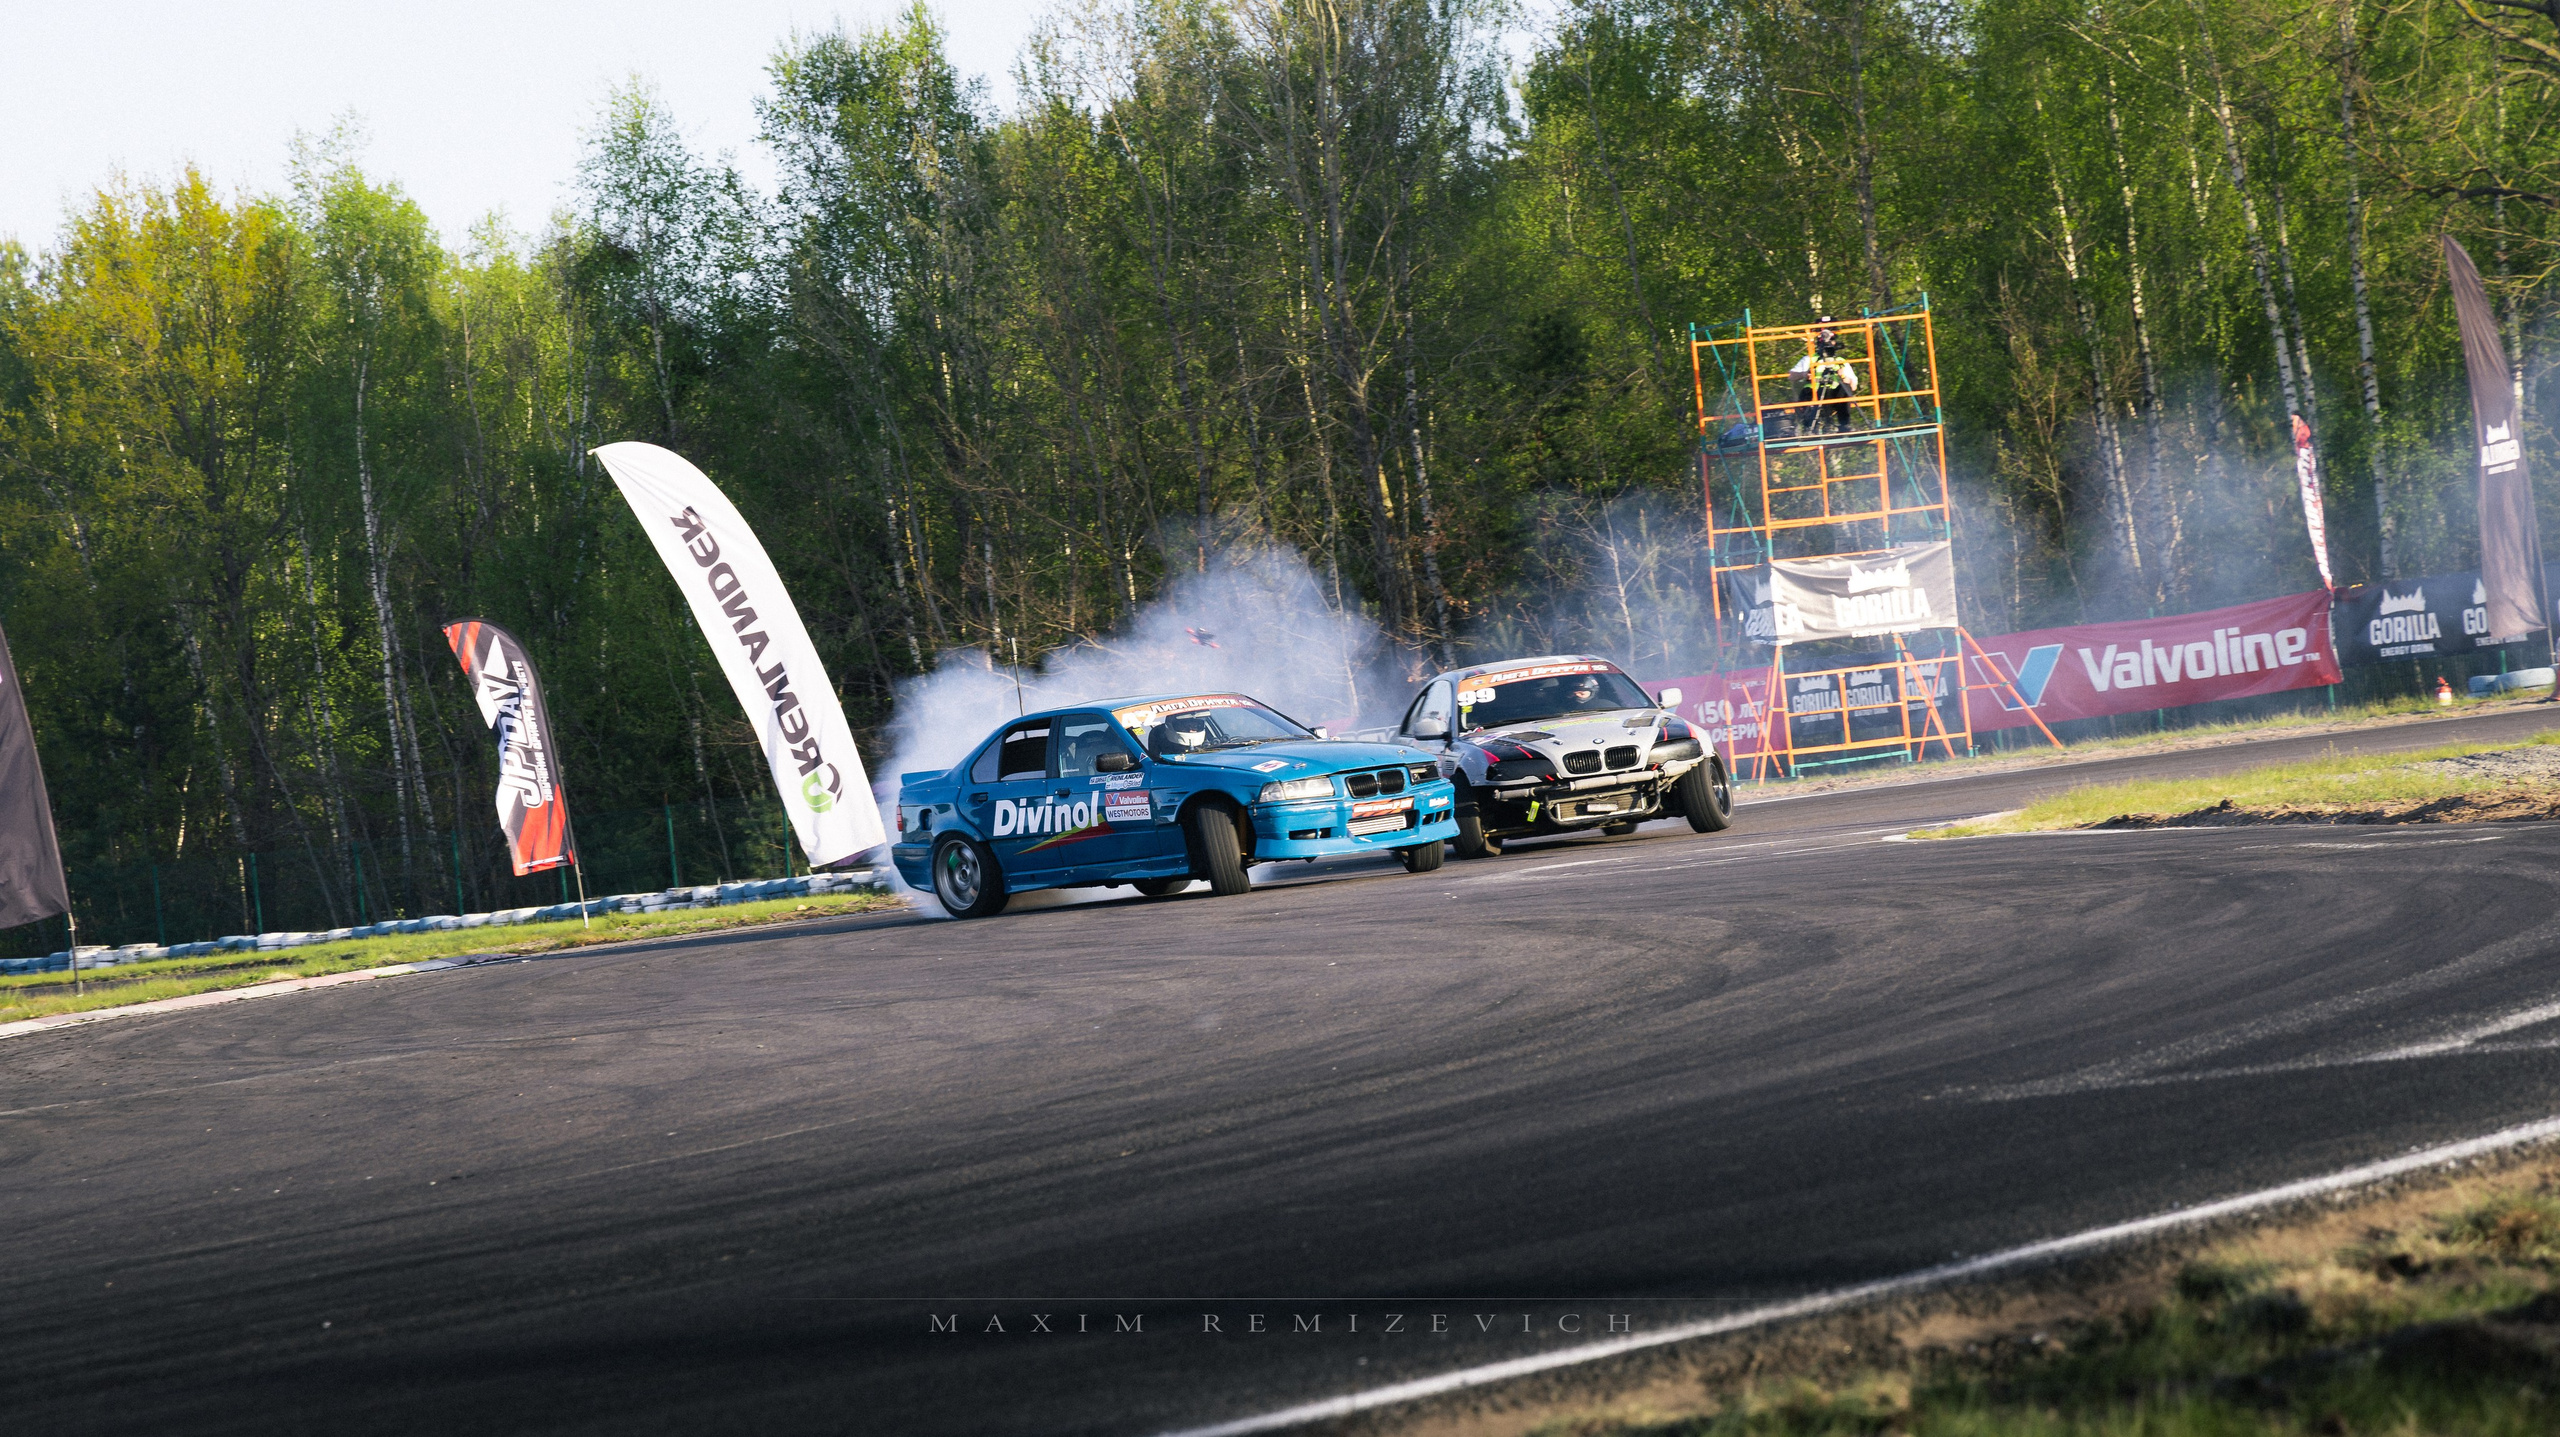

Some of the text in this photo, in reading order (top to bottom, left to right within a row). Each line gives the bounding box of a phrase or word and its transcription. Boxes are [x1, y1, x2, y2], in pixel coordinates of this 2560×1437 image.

[1834, 587, 1932, 628] GORILLA
[2370, 612, 2441, 645] GORILLA
[2078, 627, 2307, 692] Valvoline
[2380, 646, 2409, 657] ENERGY
[1457, 687, 1496, 707] 99
[1792, 690, 1841, 714] GORILLA
[1846, 684, 1893, 707] GORILLA
[1121, 709, 1161, 729] 42
[1694, 699, 1734, 724] 150
[1706, 721, 1767, 743] ОВЕРИ
[1119, 796, 1149, 804] Valvoline
[993, 790, 1099, 837] Divinol
[1107, 808, 1149, 818] WESTMOTORS
